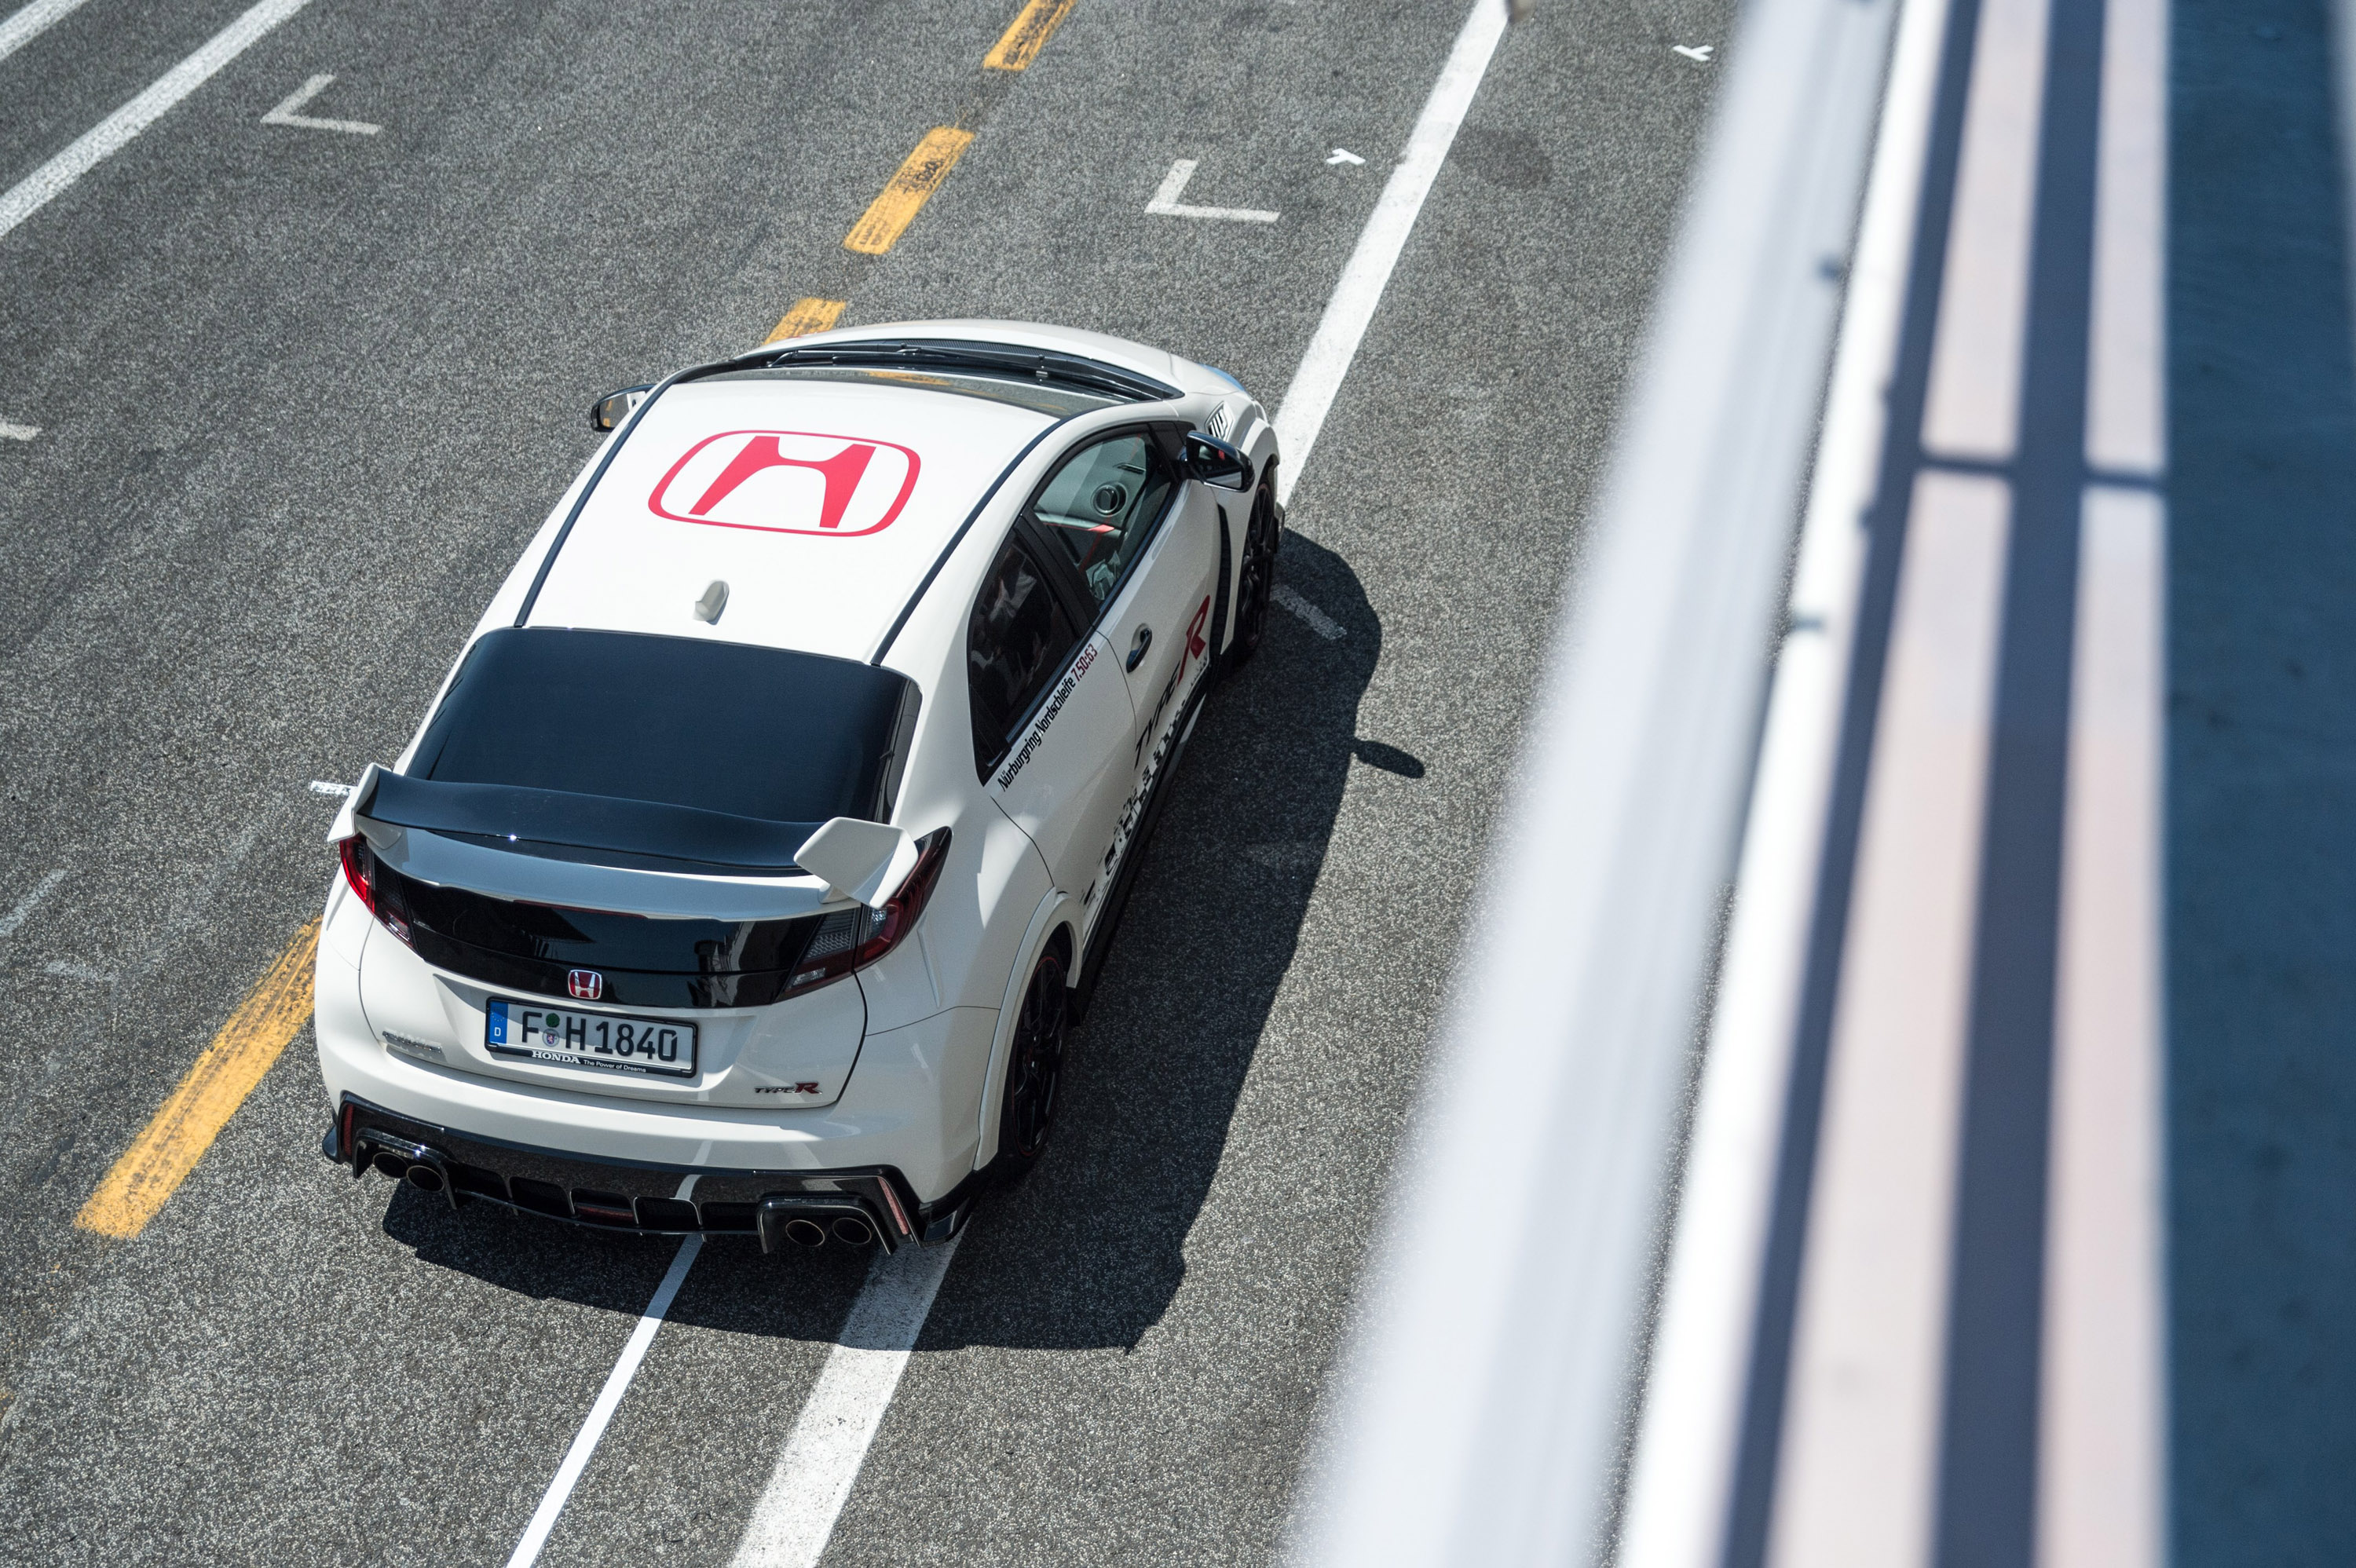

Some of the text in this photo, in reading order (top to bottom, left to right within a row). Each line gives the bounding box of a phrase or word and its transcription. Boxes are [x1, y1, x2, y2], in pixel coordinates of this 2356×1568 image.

[1177, 594, 1211, 687] R
[997, 730, 1042, 792] Nürburgring
[1035, 677, 1076, 736] Nordschleife
[494, 1027, 501, 1036] D
[594, 1021, 678, 1062] 1840
[532, 1050, 581, 1064] HONDA
